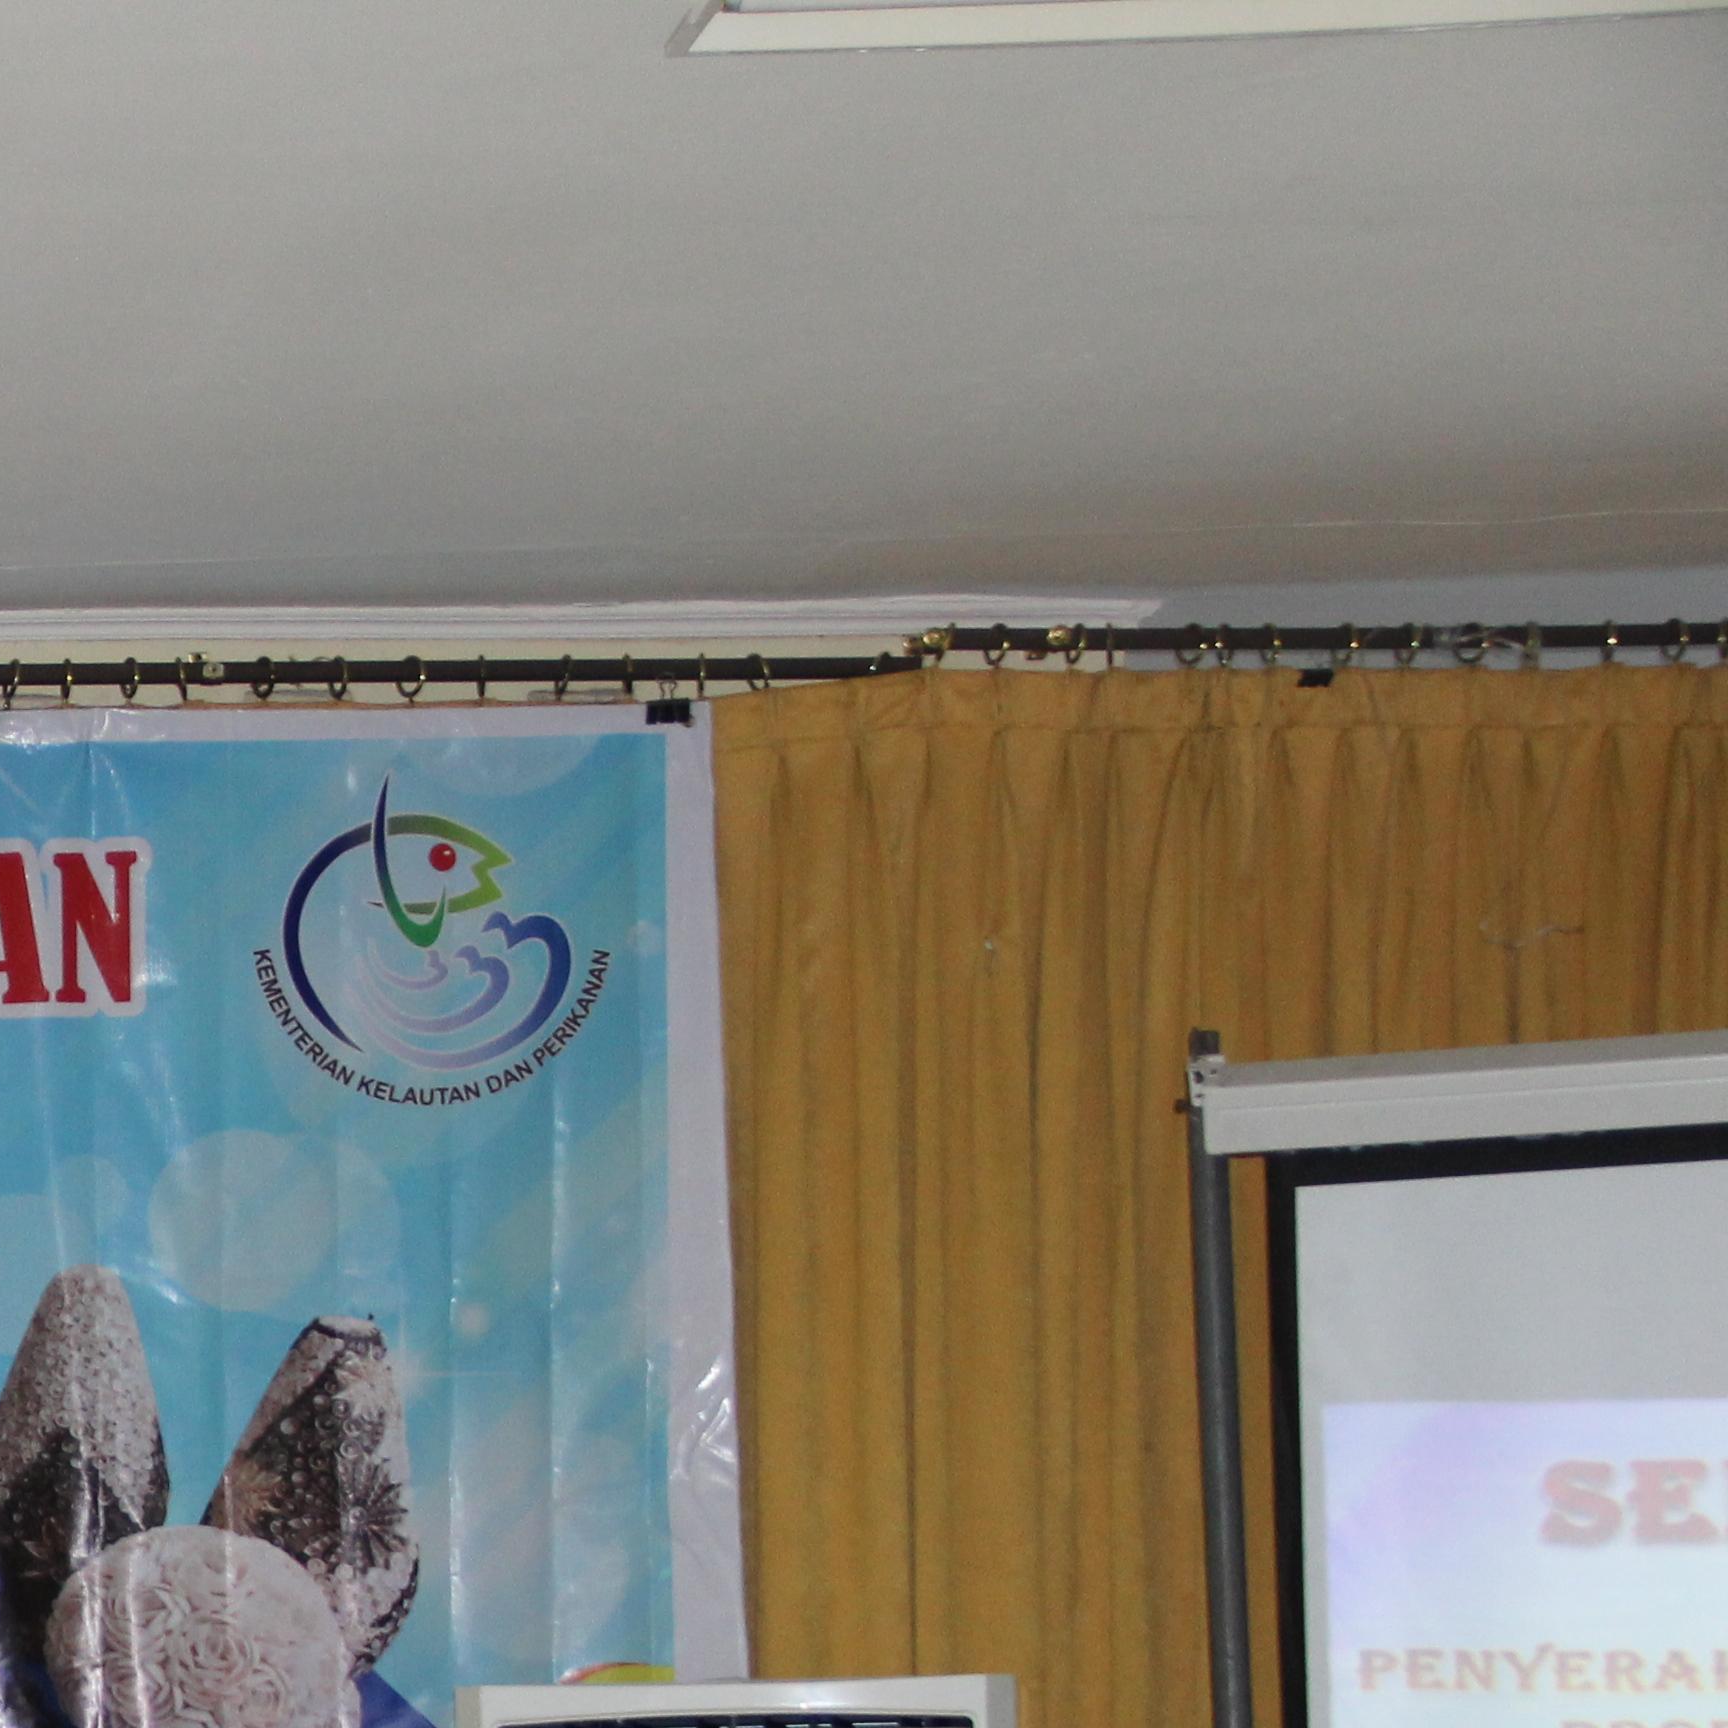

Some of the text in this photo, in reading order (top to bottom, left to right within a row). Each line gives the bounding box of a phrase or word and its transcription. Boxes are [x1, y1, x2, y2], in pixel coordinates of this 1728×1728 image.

[252, 947, 612, 1107] KEMENTERIAN KELAUTAN DAN PERIKANAN
[1540, 1458, 1728, 1548] SE
